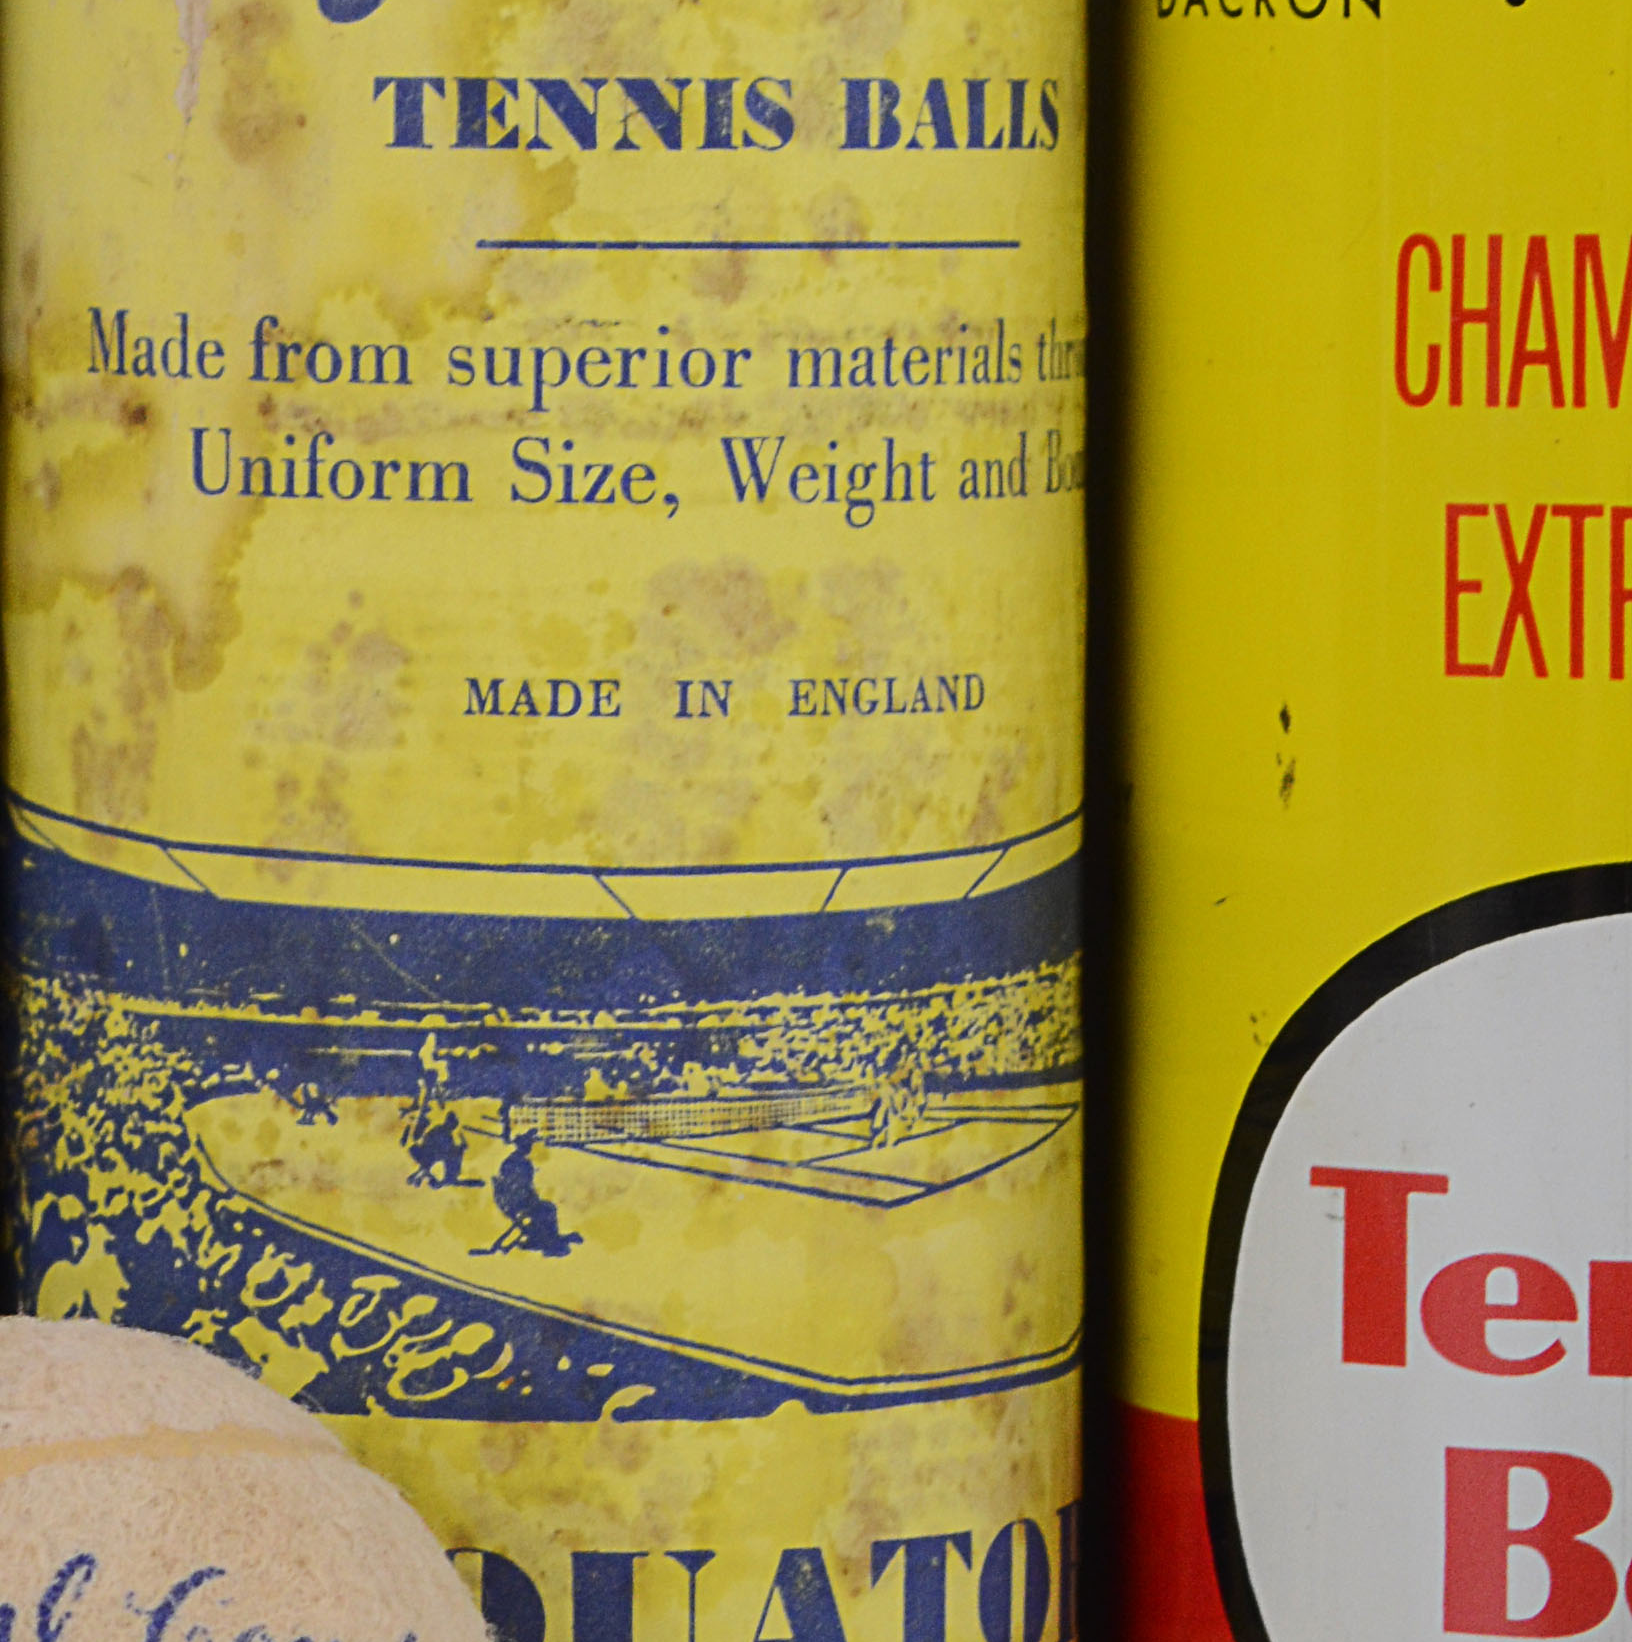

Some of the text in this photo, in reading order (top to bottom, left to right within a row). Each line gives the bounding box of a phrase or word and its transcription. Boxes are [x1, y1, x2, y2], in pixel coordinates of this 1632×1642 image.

[373, 77, 1061, 153] TENNIS BALLS
[88, 308, 226, 381] Made
[249, 315, 414, 387] from
[446, 326, 751, 412] superior
[788, 317, 1023, 387] materials
[191, 427, 473, 503] Uniform
[511, 437, 682, 517] Size,
[721, 435, 938, 527] Weight
[959, 431, 1028, 500] and
[464, 674, 985, 718] MADE IN ENGLAND
[1443, 1447, 1632, 1639] B
